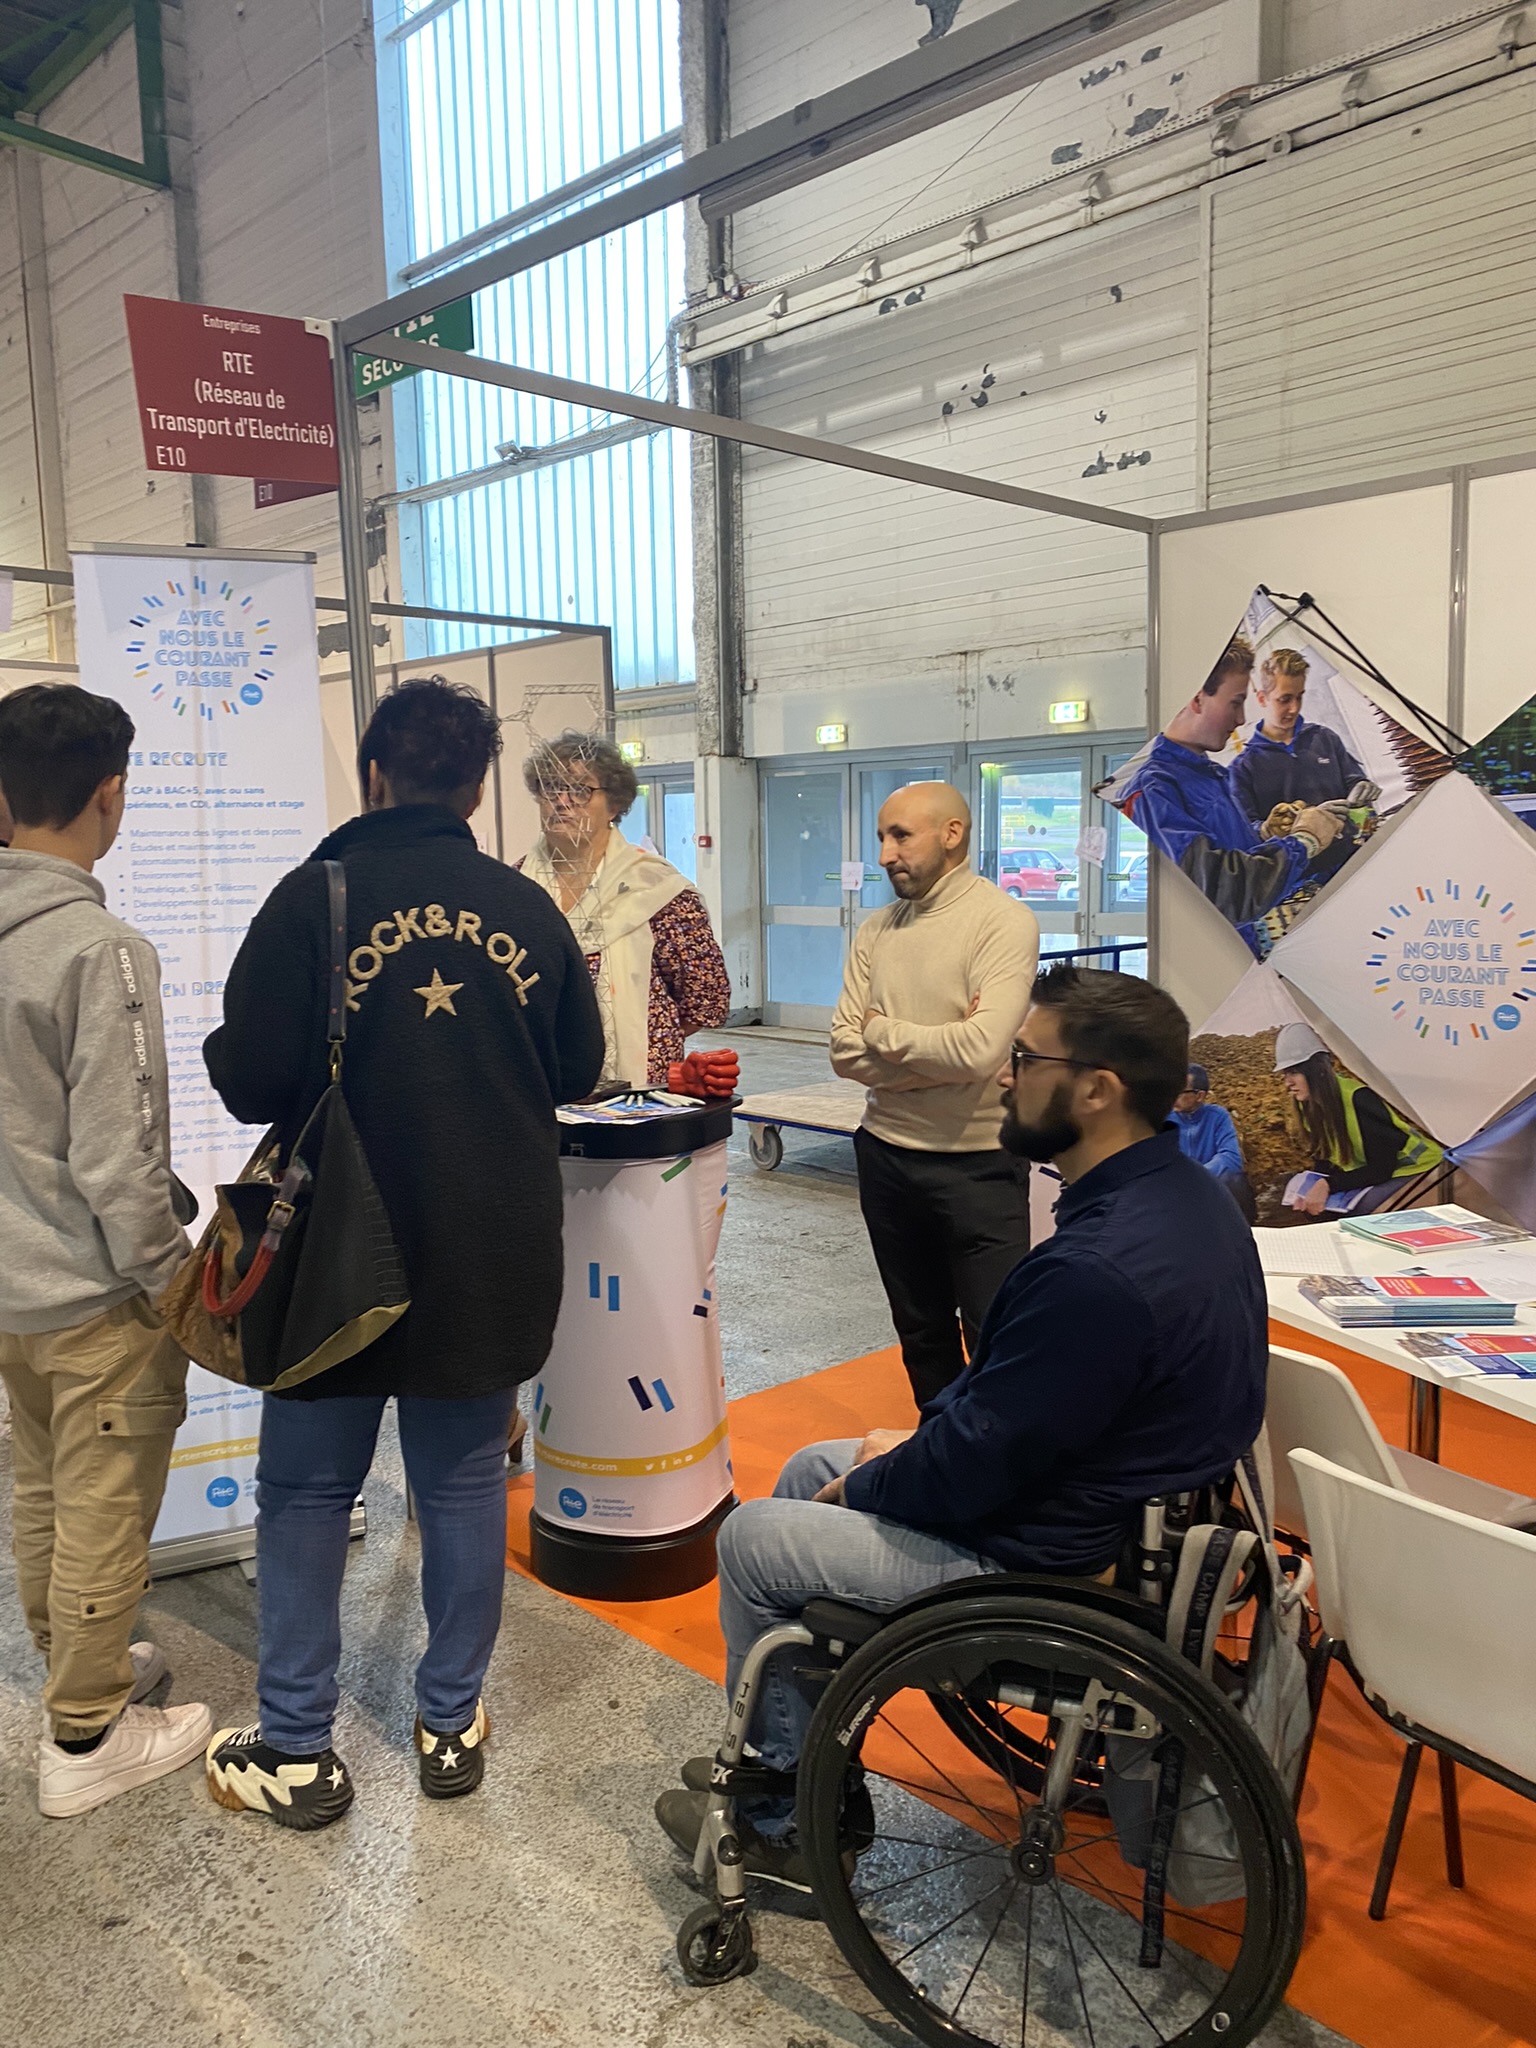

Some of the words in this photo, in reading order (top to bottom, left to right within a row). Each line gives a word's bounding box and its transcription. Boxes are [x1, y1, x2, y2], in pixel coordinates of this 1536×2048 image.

[203, 313, 261, 335] Entreprises
[222, 350, 255, 376] RTE
[194, 380, 262, 408] (Réseau
[266, 388, 286, 410] de
[146, 408, 232, 440] Transport
[234, 416, 334, 449] d'Electricité)
[156, 445, 186, 467] E10
[176, 609, 226, 627] AVEC
[159, 630, 219, 647] NOUS
[222, 631, 245, 648] LE
[154, 650, 252, 668] COURANT
[176, 671, 234, 688] PASSE
[127, 752, 144, 766] TE
[149, 752, 229, 767] RECRUTE
[1424, 919, 1480, 938] AVEC
[1403, 942, 1471, 961] NOUS
[1476, 943, 1503, 962] LE
[117, 947, 136, 993] adidas
[1396, 963, 1510, 985] COURANT
[192, 981, 225, 997] BRE
[1418, 987, 1486, 1008] PASSE
[132, 1020, 148, 1067] adidas
